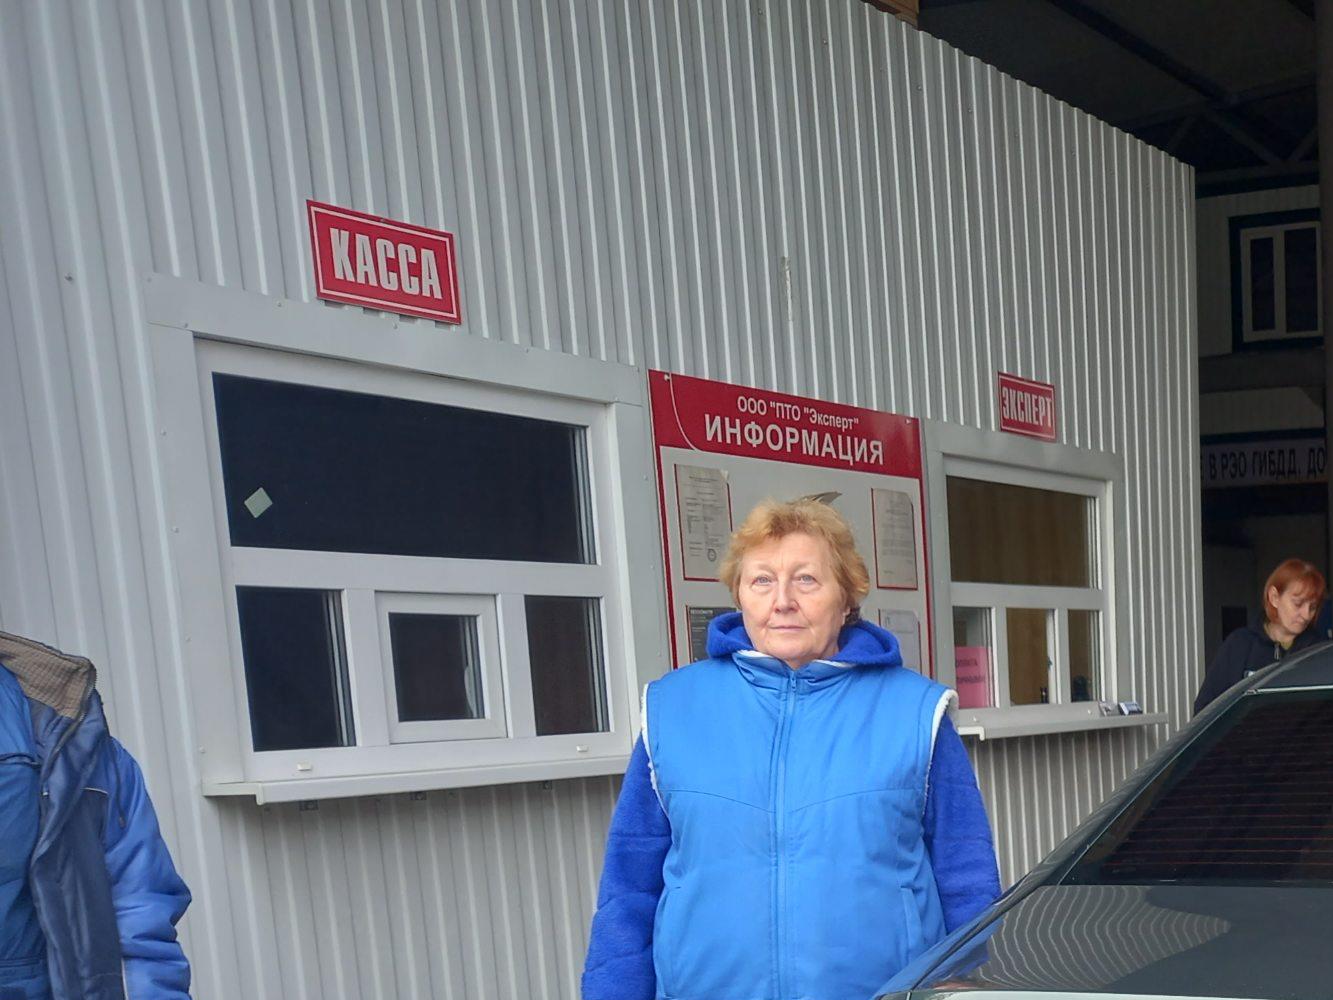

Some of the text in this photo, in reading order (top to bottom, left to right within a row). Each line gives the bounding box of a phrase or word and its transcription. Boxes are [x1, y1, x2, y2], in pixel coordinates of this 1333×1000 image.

[329, 227, 443, 299] КАССА
[737, 396, 767, 416] ООО
[1002, 386, 1052, 427] ЭКСПЕРТ
[704, 413, 884, 467] ИНФОРМАЦИЯ
[1209, 452, 1217, 480] В
[1221, 451, 1248, 479] РЭО
